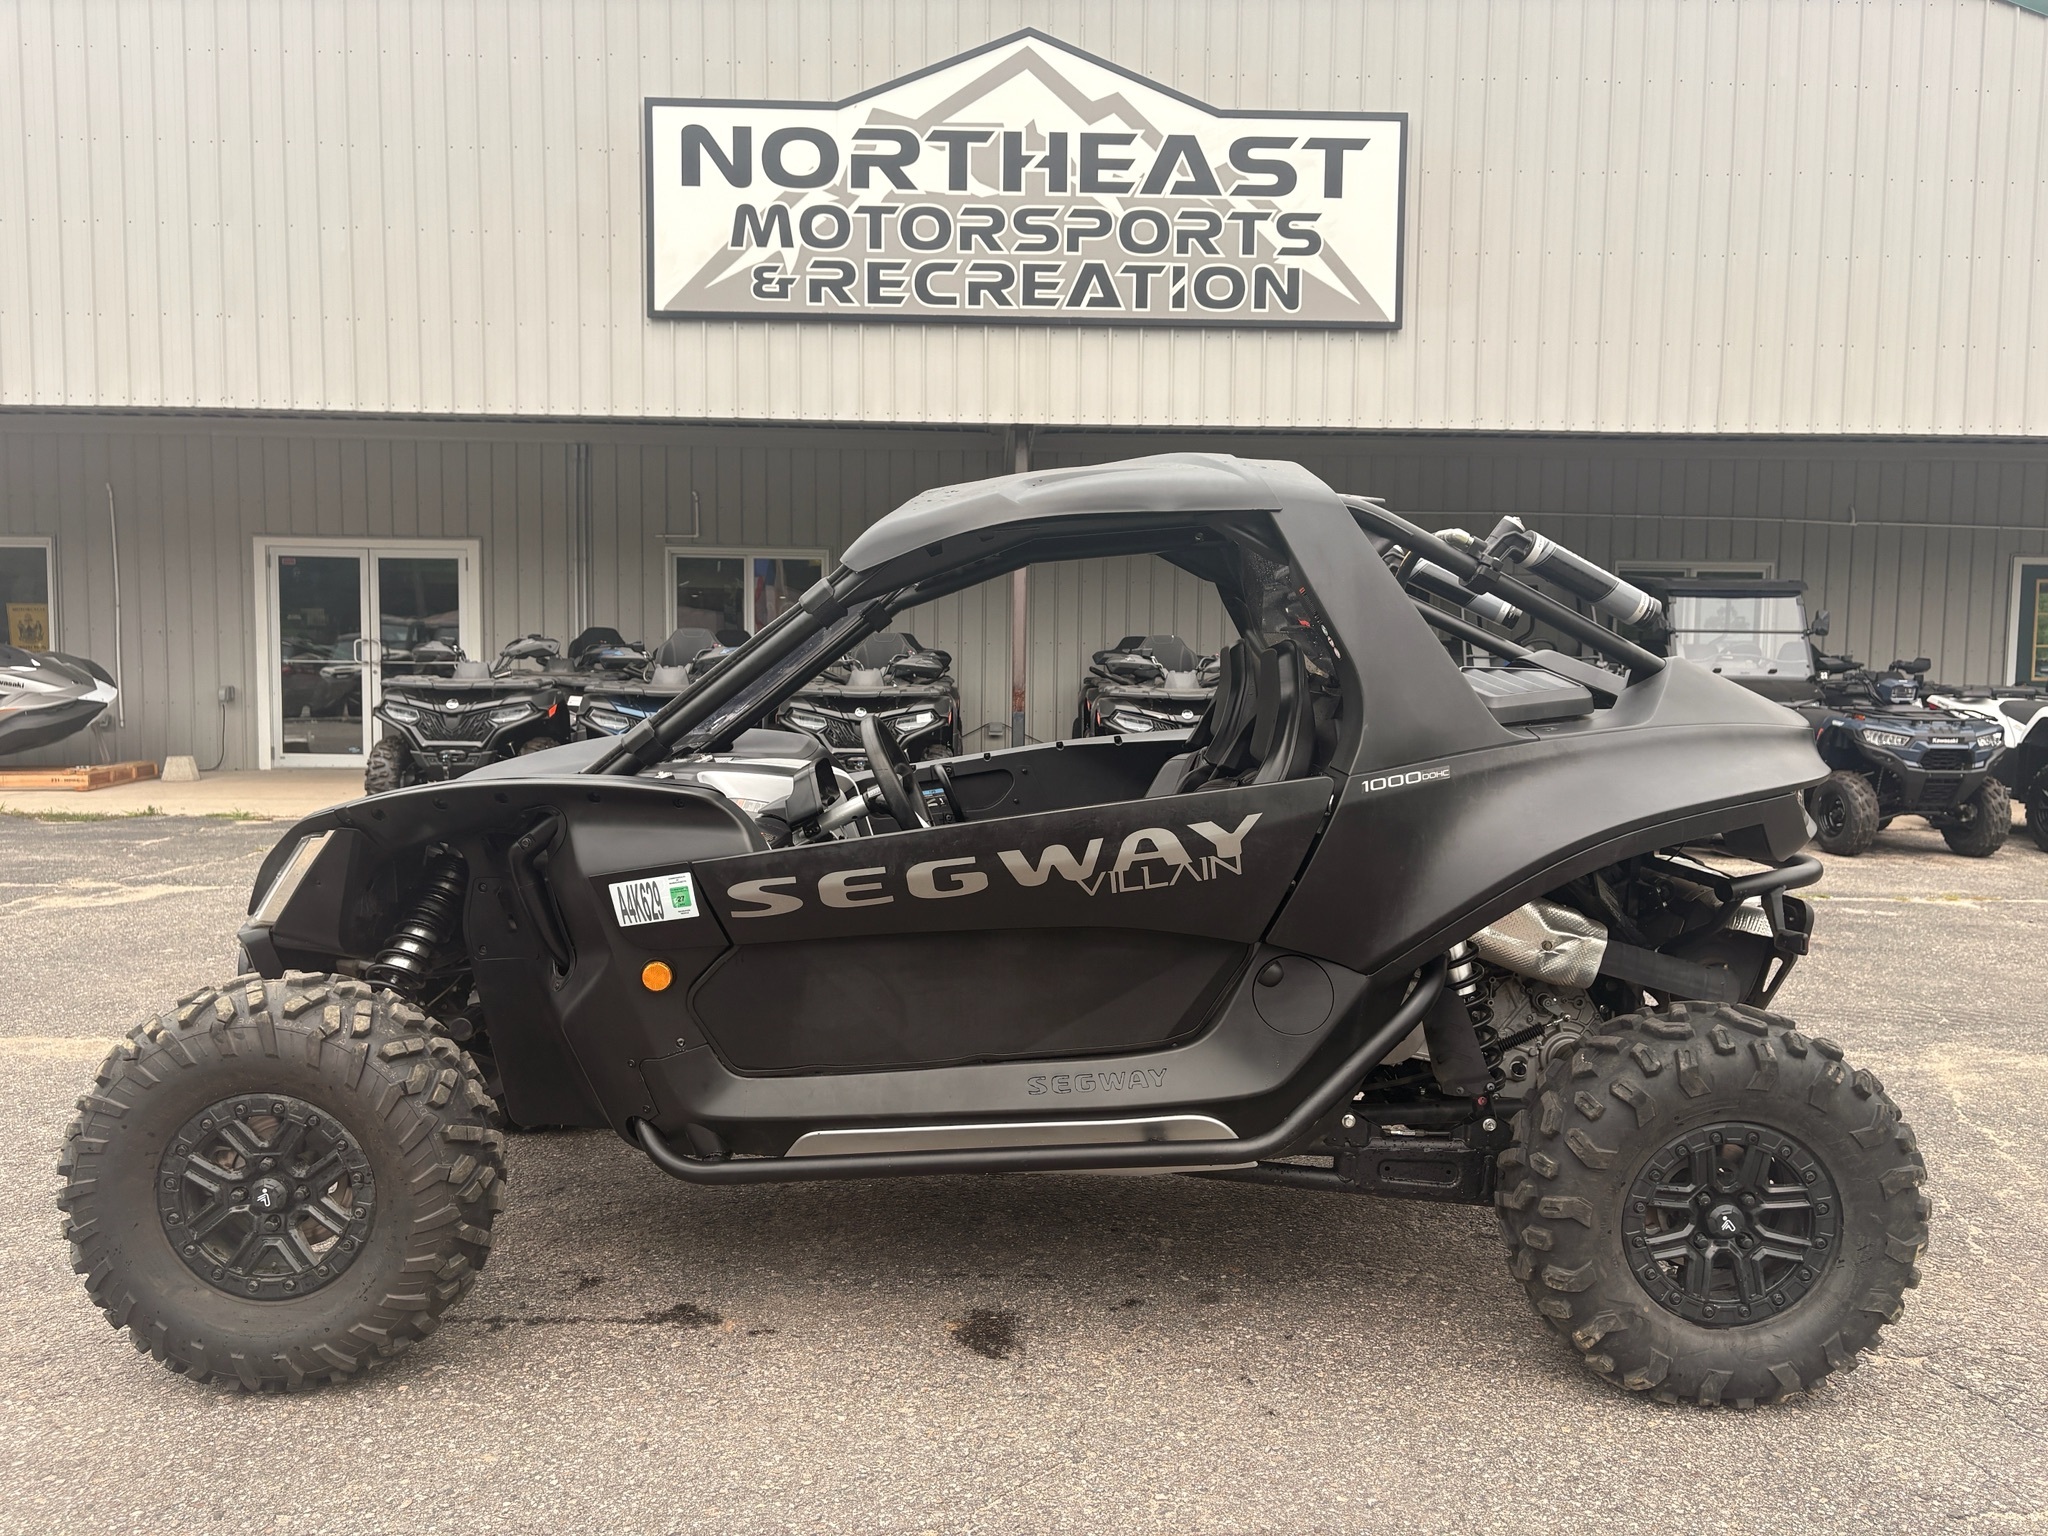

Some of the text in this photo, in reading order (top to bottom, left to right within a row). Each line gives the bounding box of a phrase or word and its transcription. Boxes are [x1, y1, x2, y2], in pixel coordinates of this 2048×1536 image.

[681, 124, 1371, 199] NORTHEAST
[732, 203, 1323, 257] MOTORSPORTS
[752, 260, 1301, 311] & RECREATION
[1361, 771, 1421, 792] 1000
[727, 812, 1262, 918] SEGWAY
[1073, 855, 1243, 896] VILLAIN
[616, 880, 665, 924] A4K629
[1027, 1068, 1167, 1095] SEGWAY
